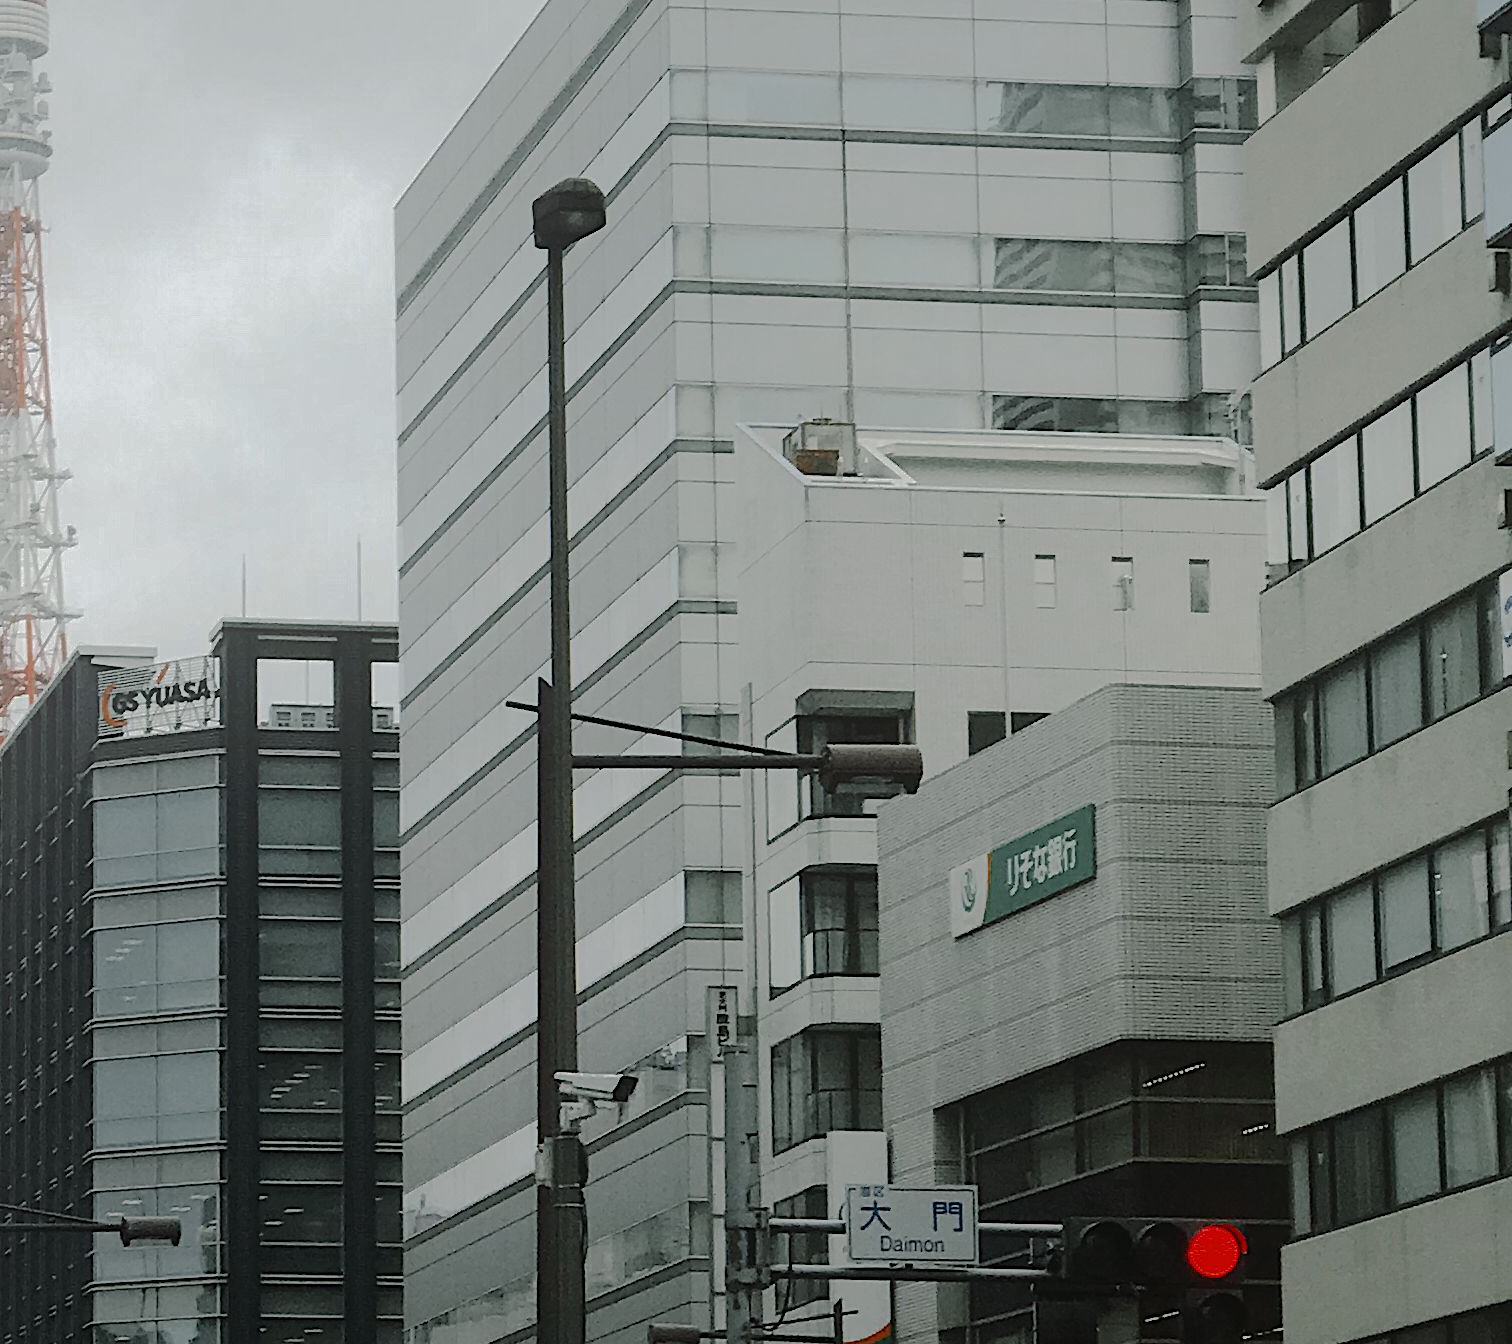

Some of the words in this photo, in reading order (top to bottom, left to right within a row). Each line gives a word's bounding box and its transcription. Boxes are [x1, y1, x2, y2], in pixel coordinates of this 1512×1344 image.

[140, 677, 211, 708] YUASA
[1006, 828, 1078, 897] りそな銀行
[860, 1201, 964, 1232] 大門
[880, 1235, 945, 1253] Daimon
